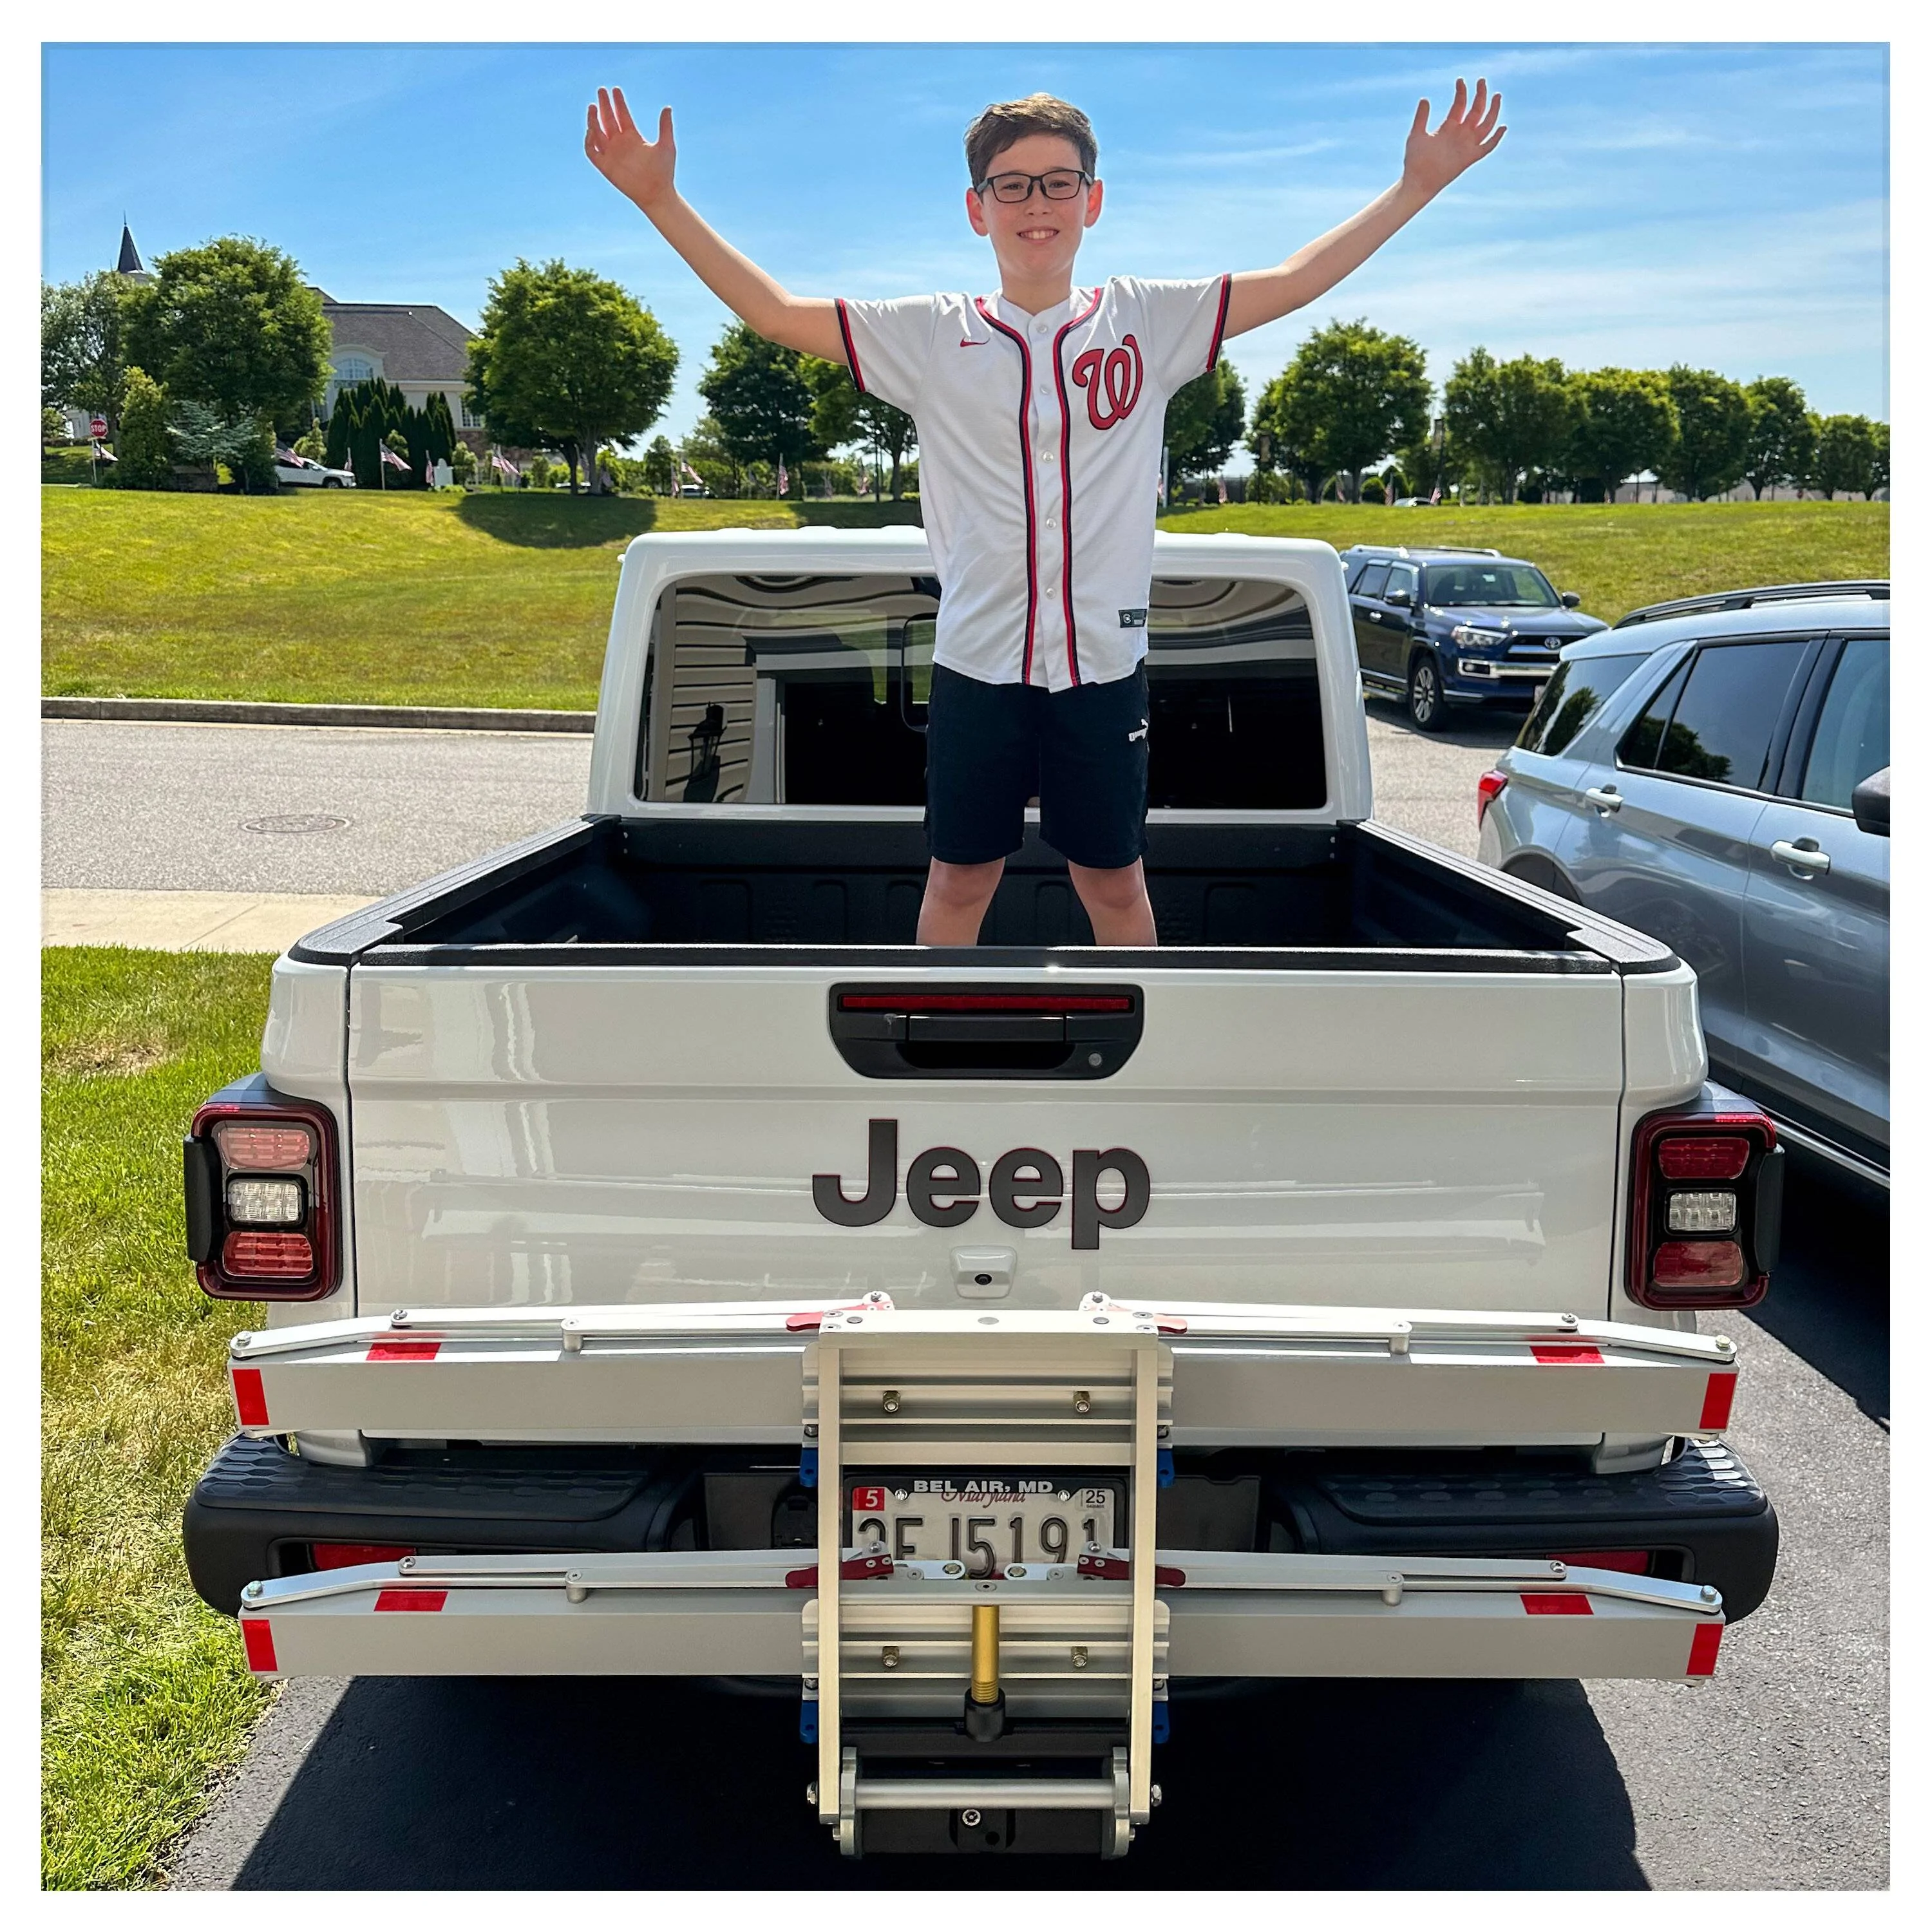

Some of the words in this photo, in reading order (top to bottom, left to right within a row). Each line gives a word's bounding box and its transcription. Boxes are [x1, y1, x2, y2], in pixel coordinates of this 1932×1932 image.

[812, 1119, 1150, 1249] Jeep
[913, 1480, 958, 1493] BEL
[965, 1480, 1010, 1493] AIR,
[1018, 1481, 1054, 1493] MD
[865, 1489, 878, 1508] 5
[1085, 1490, 1106, 1504] 25
